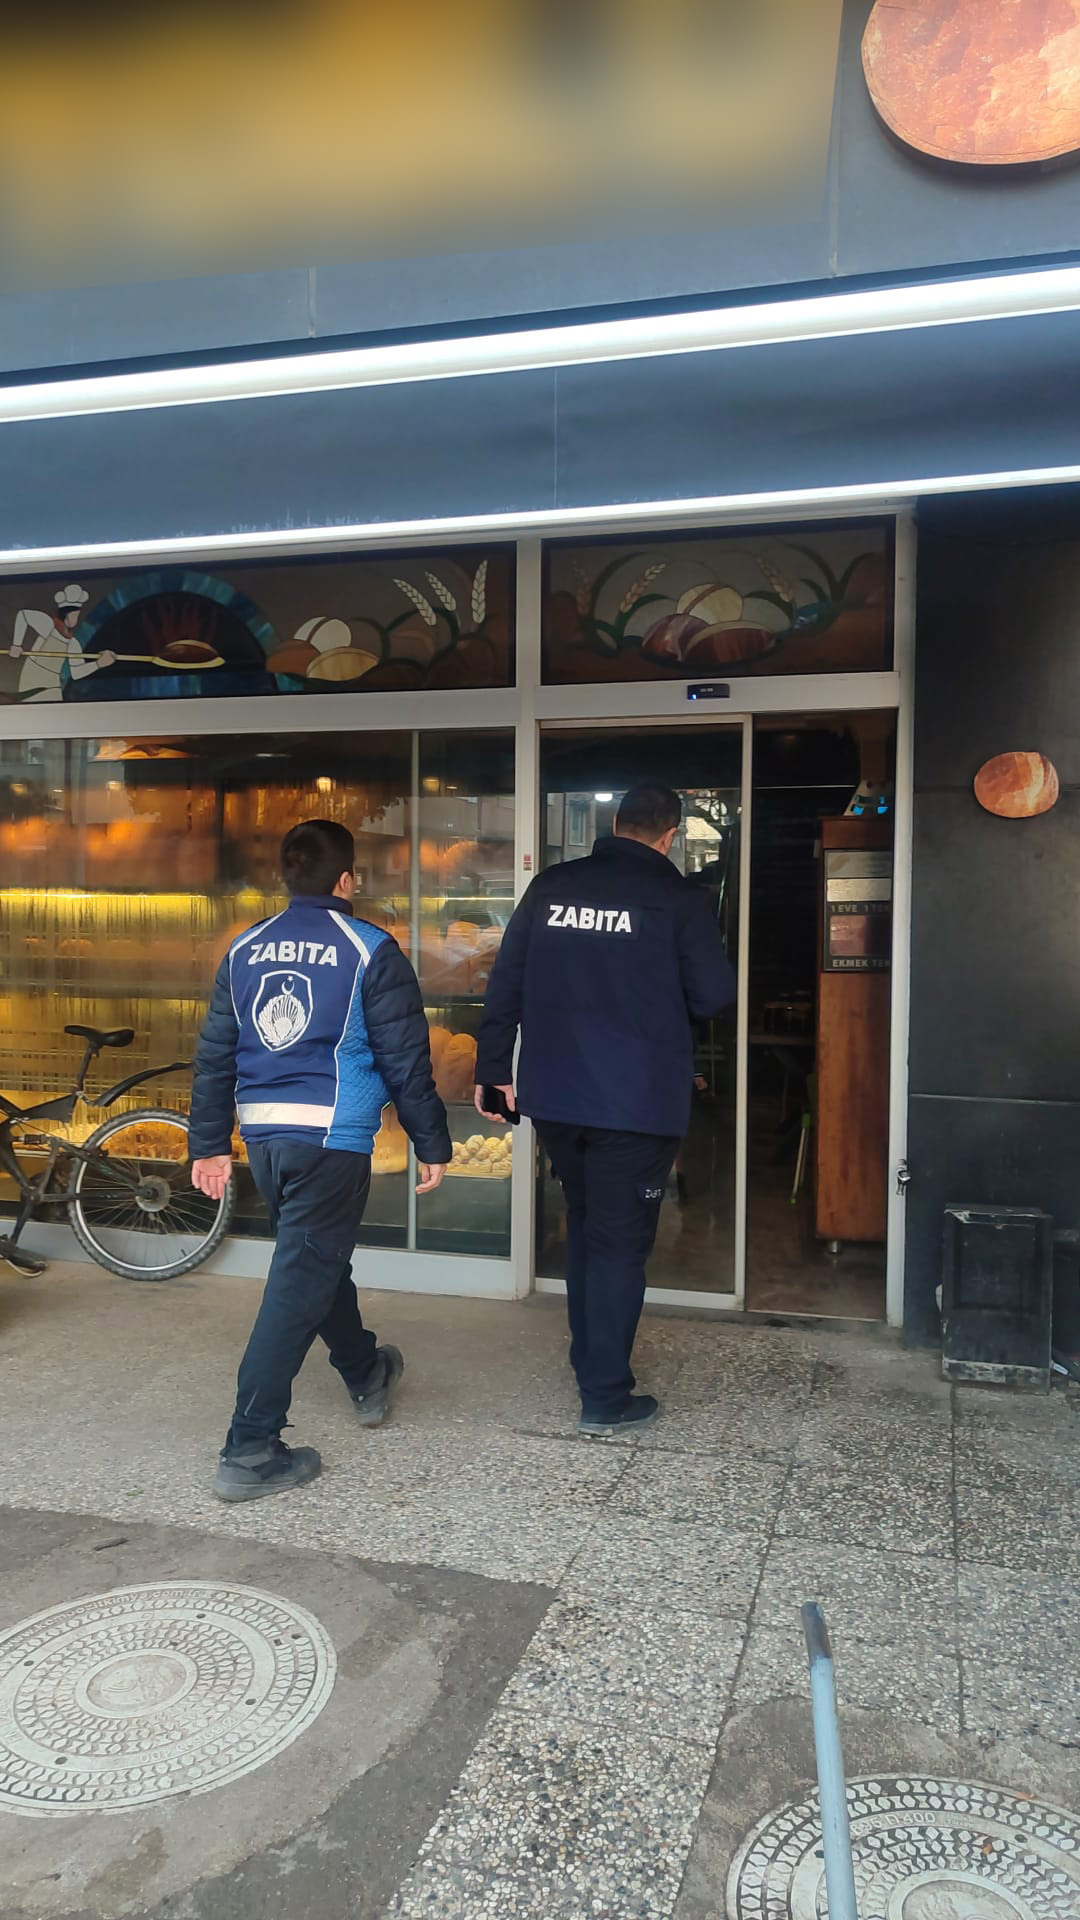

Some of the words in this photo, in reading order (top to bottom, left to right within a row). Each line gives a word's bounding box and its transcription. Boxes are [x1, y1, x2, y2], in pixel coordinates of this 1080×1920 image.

[547, 904, 632, 933] ZABITA
[248, 940, 338, 967] ZABITA
[832, 959, 869, 968] EKMEK
